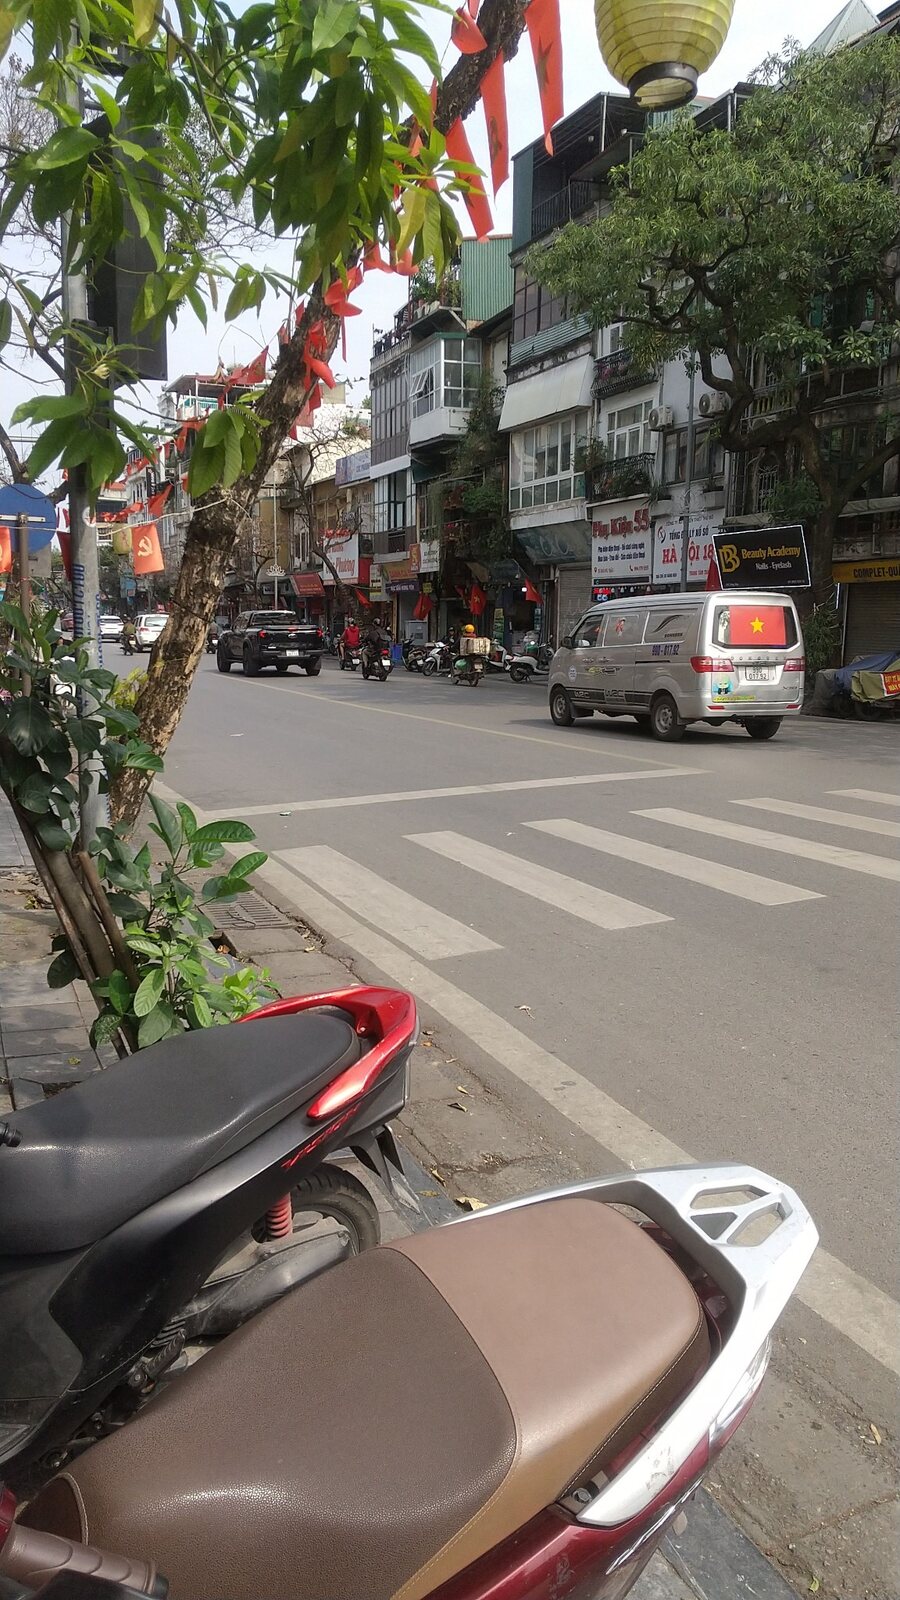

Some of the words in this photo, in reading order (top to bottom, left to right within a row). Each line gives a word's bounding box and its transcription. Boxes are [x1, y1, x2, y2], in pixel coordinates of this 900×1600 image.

[592, 520, 609, 540] Phụ
[610, 515, 633, 538] Kiện
[634, 508, 650, 532] 55
[669, 529, 681, 540] TỔNG
[702, 524, 709, 536] SỐ
[662, 543, 678, 564] HÀ
[687, 541, 700, 566] ỘI
[741, 548, 767, 560] Beauty
[767, 545, 801, 558] Academy
[755, 562, 769, 570] Nails
[772, 561, 792, 570] Eyelash
[853, 566, 900, 578] COMPLET-QU
[663, 644, 680, 656] 017.92
